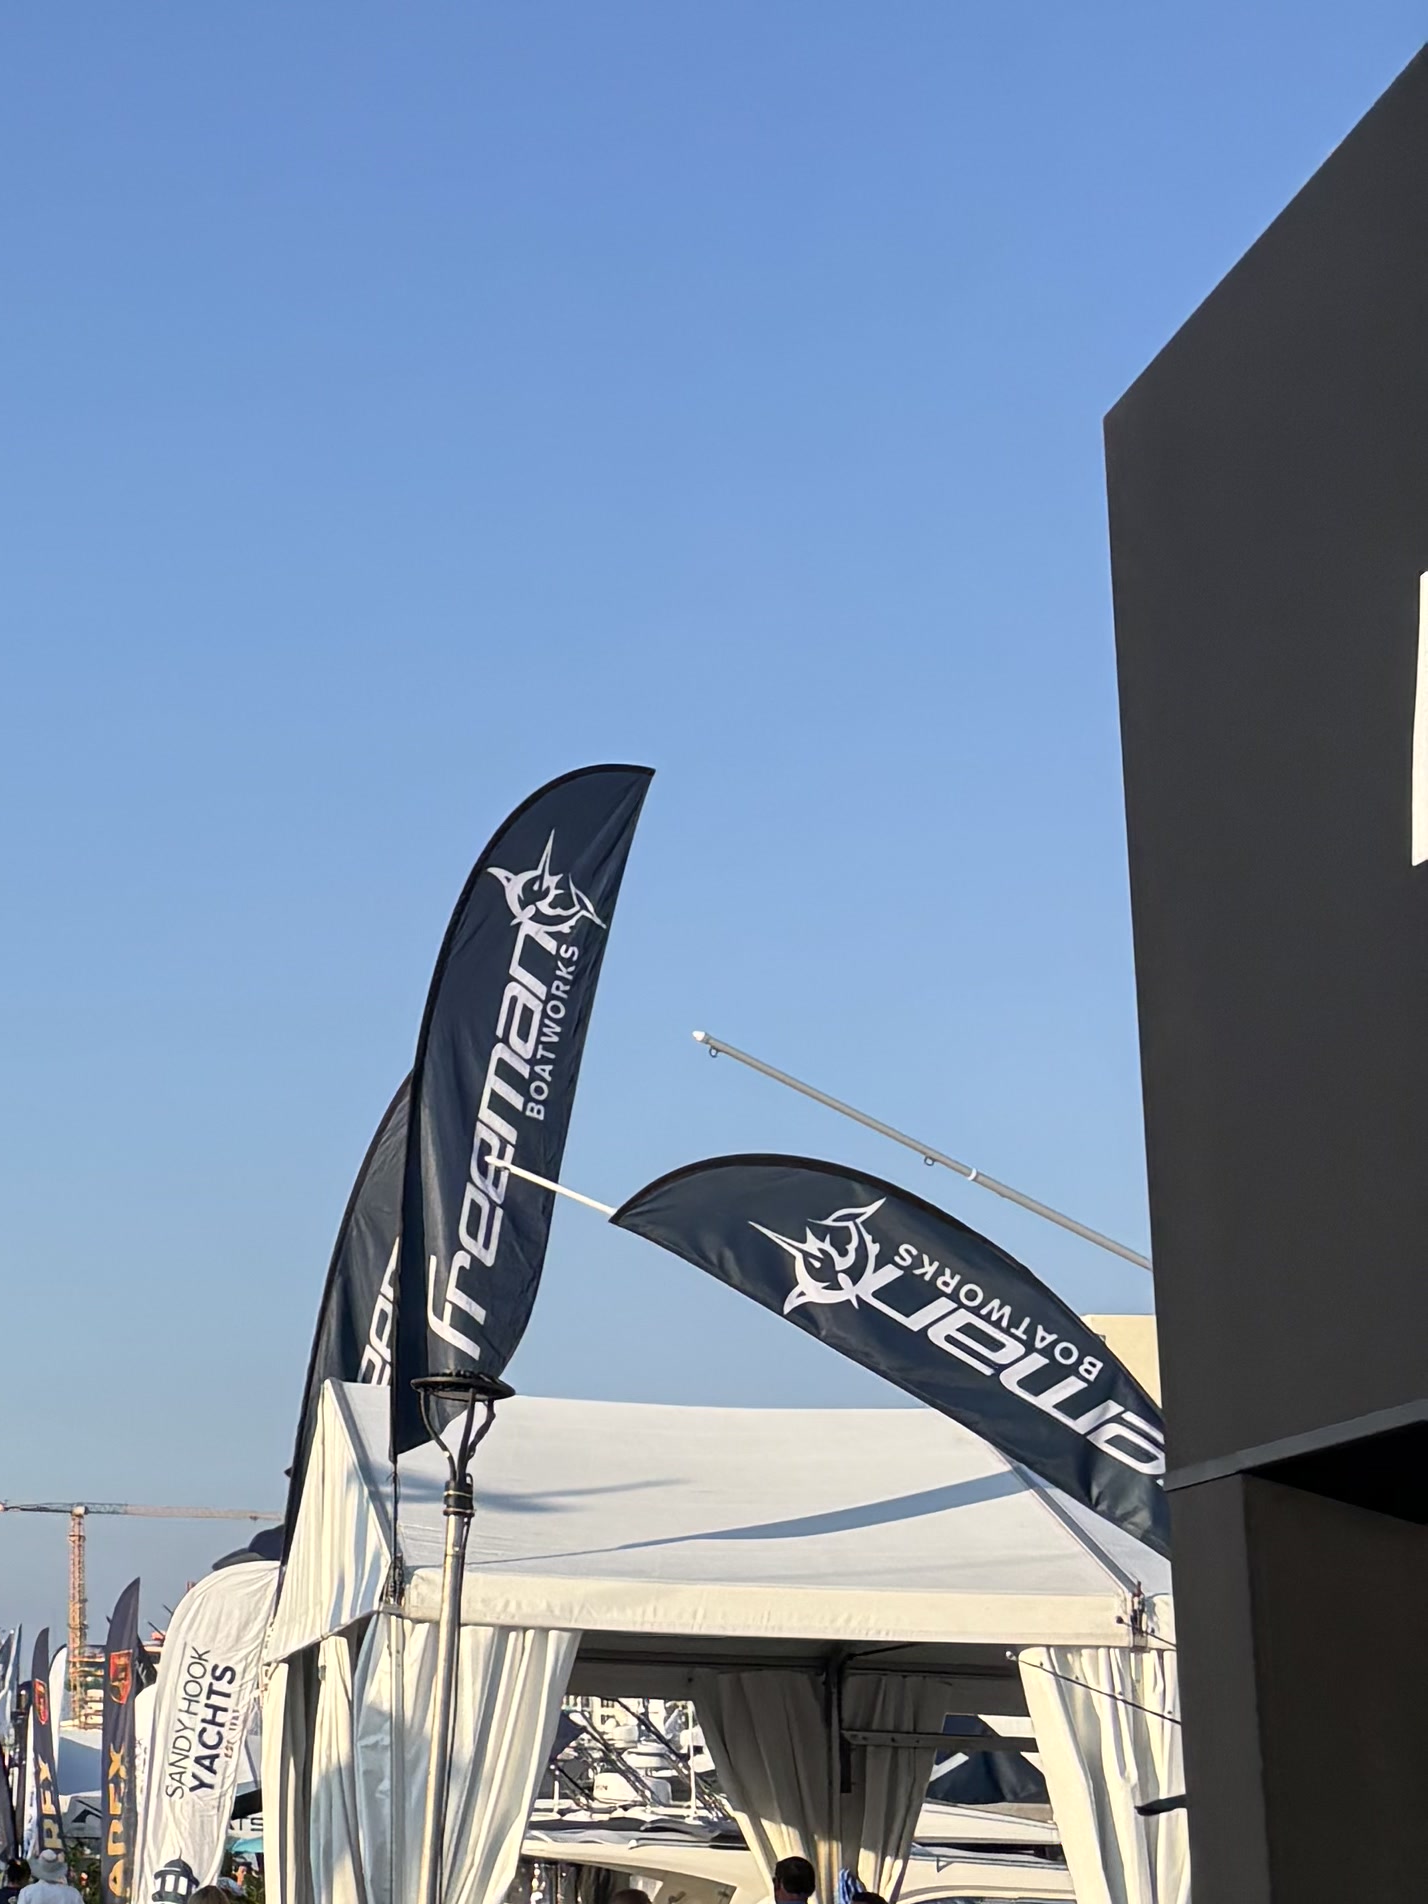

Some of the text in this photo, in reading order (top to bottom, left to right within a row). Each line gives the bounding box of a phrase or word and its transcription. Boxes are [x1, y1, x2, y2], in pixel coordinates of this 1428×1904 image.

[525, 943, 580, 1121] BOATWORKS
[427, 918, 560, 1361] freeman
[854, 1262, 1166, 1484] eman
[894, 1242, 1104, 1382] BOATWORKS
[165, 1646, 211, 1800] SANDY HOOK
[188, 1663, 237, 1794] YACHTS
[37, 1753, 64, 1849] REX
